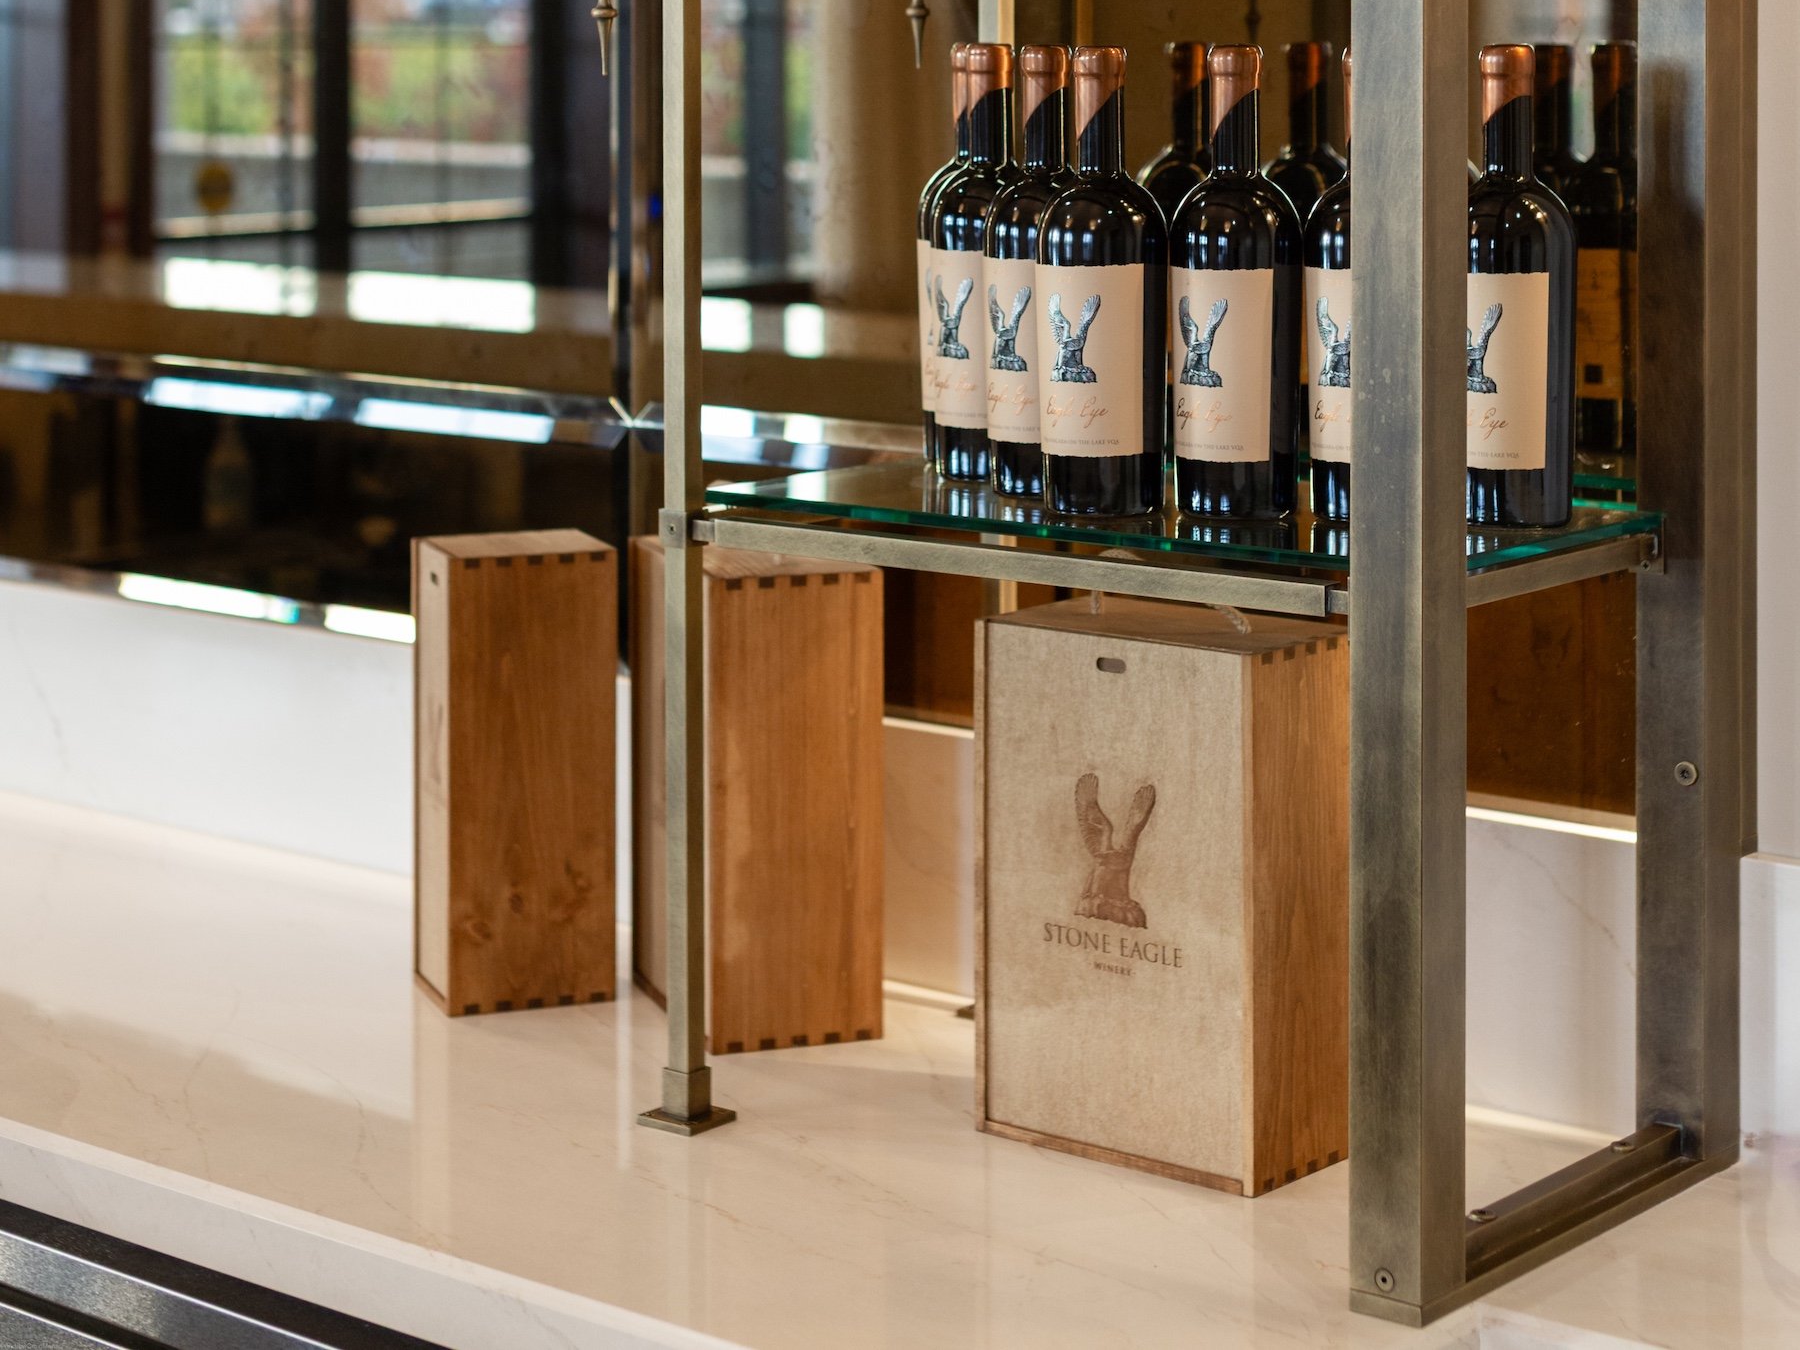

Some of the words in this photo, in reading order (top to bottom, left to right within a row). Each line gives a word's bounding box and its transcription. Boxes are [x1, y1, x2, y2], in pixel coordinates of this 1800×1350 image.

[1080, 396, 1109, 429] Eye
[1204, 400, 1233, 434] Eye
[1479, 407, 1510, 441] Eye
[1043, 922, 1112, 954] STONE
[1119, 937, 1184, 968] EAGLE
